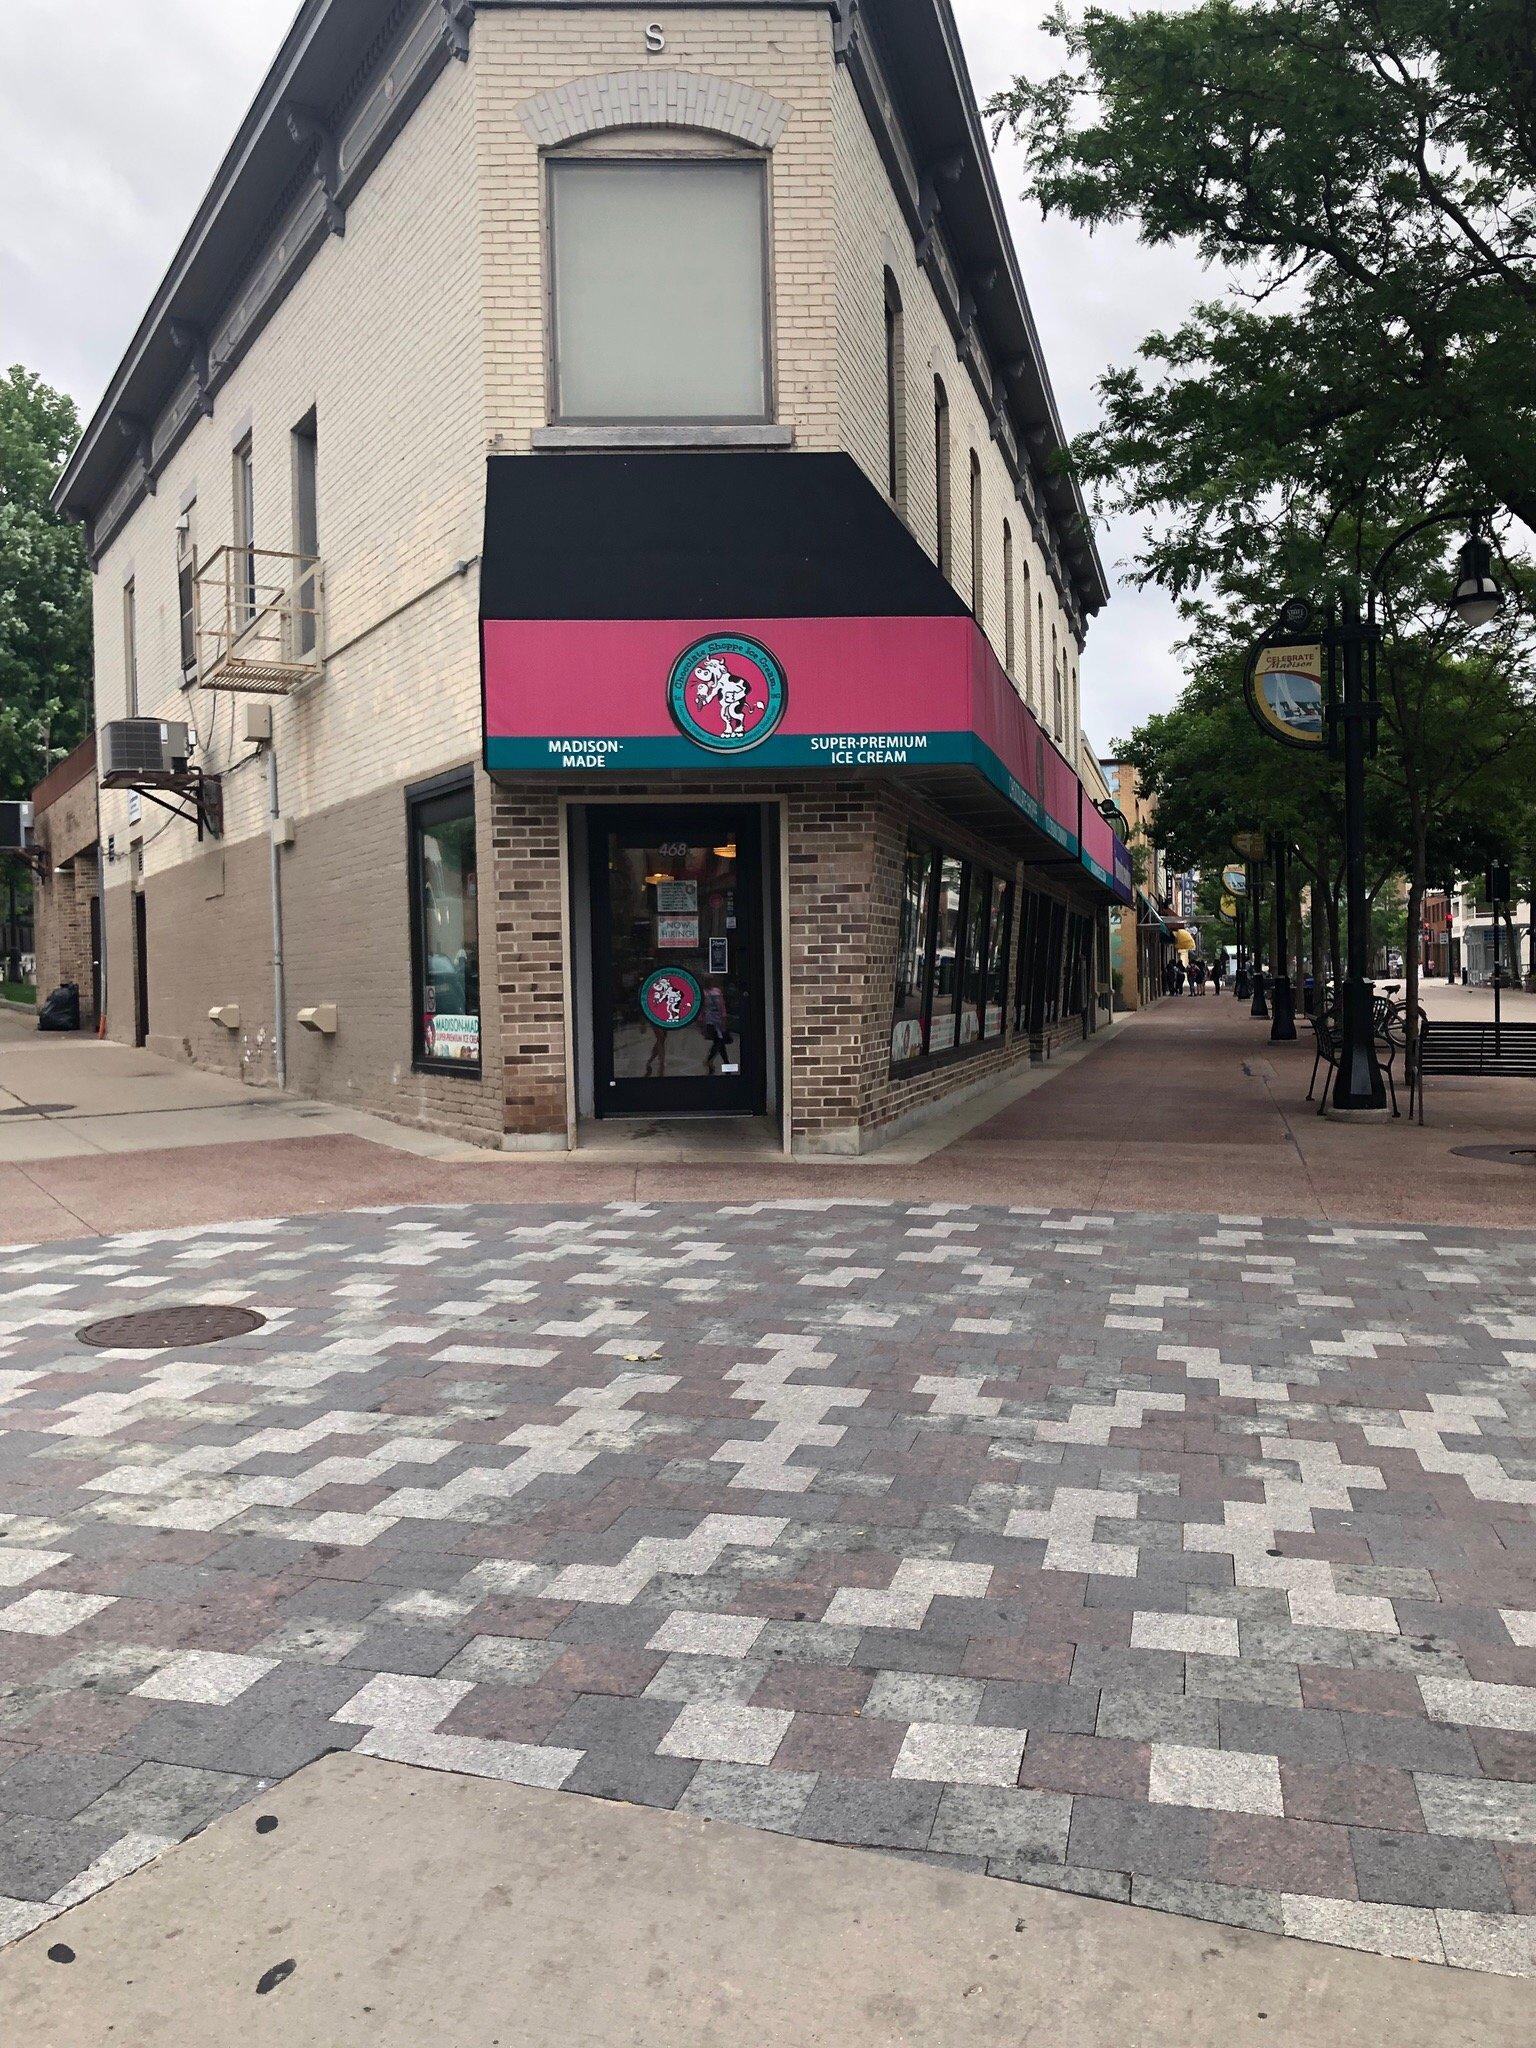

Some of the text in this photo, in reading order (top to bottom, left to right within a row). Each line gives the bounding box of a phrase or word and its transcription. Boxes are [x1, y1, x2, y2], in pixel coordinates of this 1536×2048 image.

[645, 22, 665, 51] S
[1266, 653, 1315, 663] CELEBRATE
[674, 642, 777, 690] Chocolate Shoppe Ice Cream
[1265, 660, 1313, 671] Madison
[548, 740, 624, 753] MADISON-
[811, 735, 928, 750] SUPER-PREMIUM
[562, 755, 606, 768] MADE
[831, 750, 907, 764] ICE CREAM
[660, 843, 687, 857] 468
[666, 921, 689, 929] NOW
[661, 930, 695, 938] HIRING!
